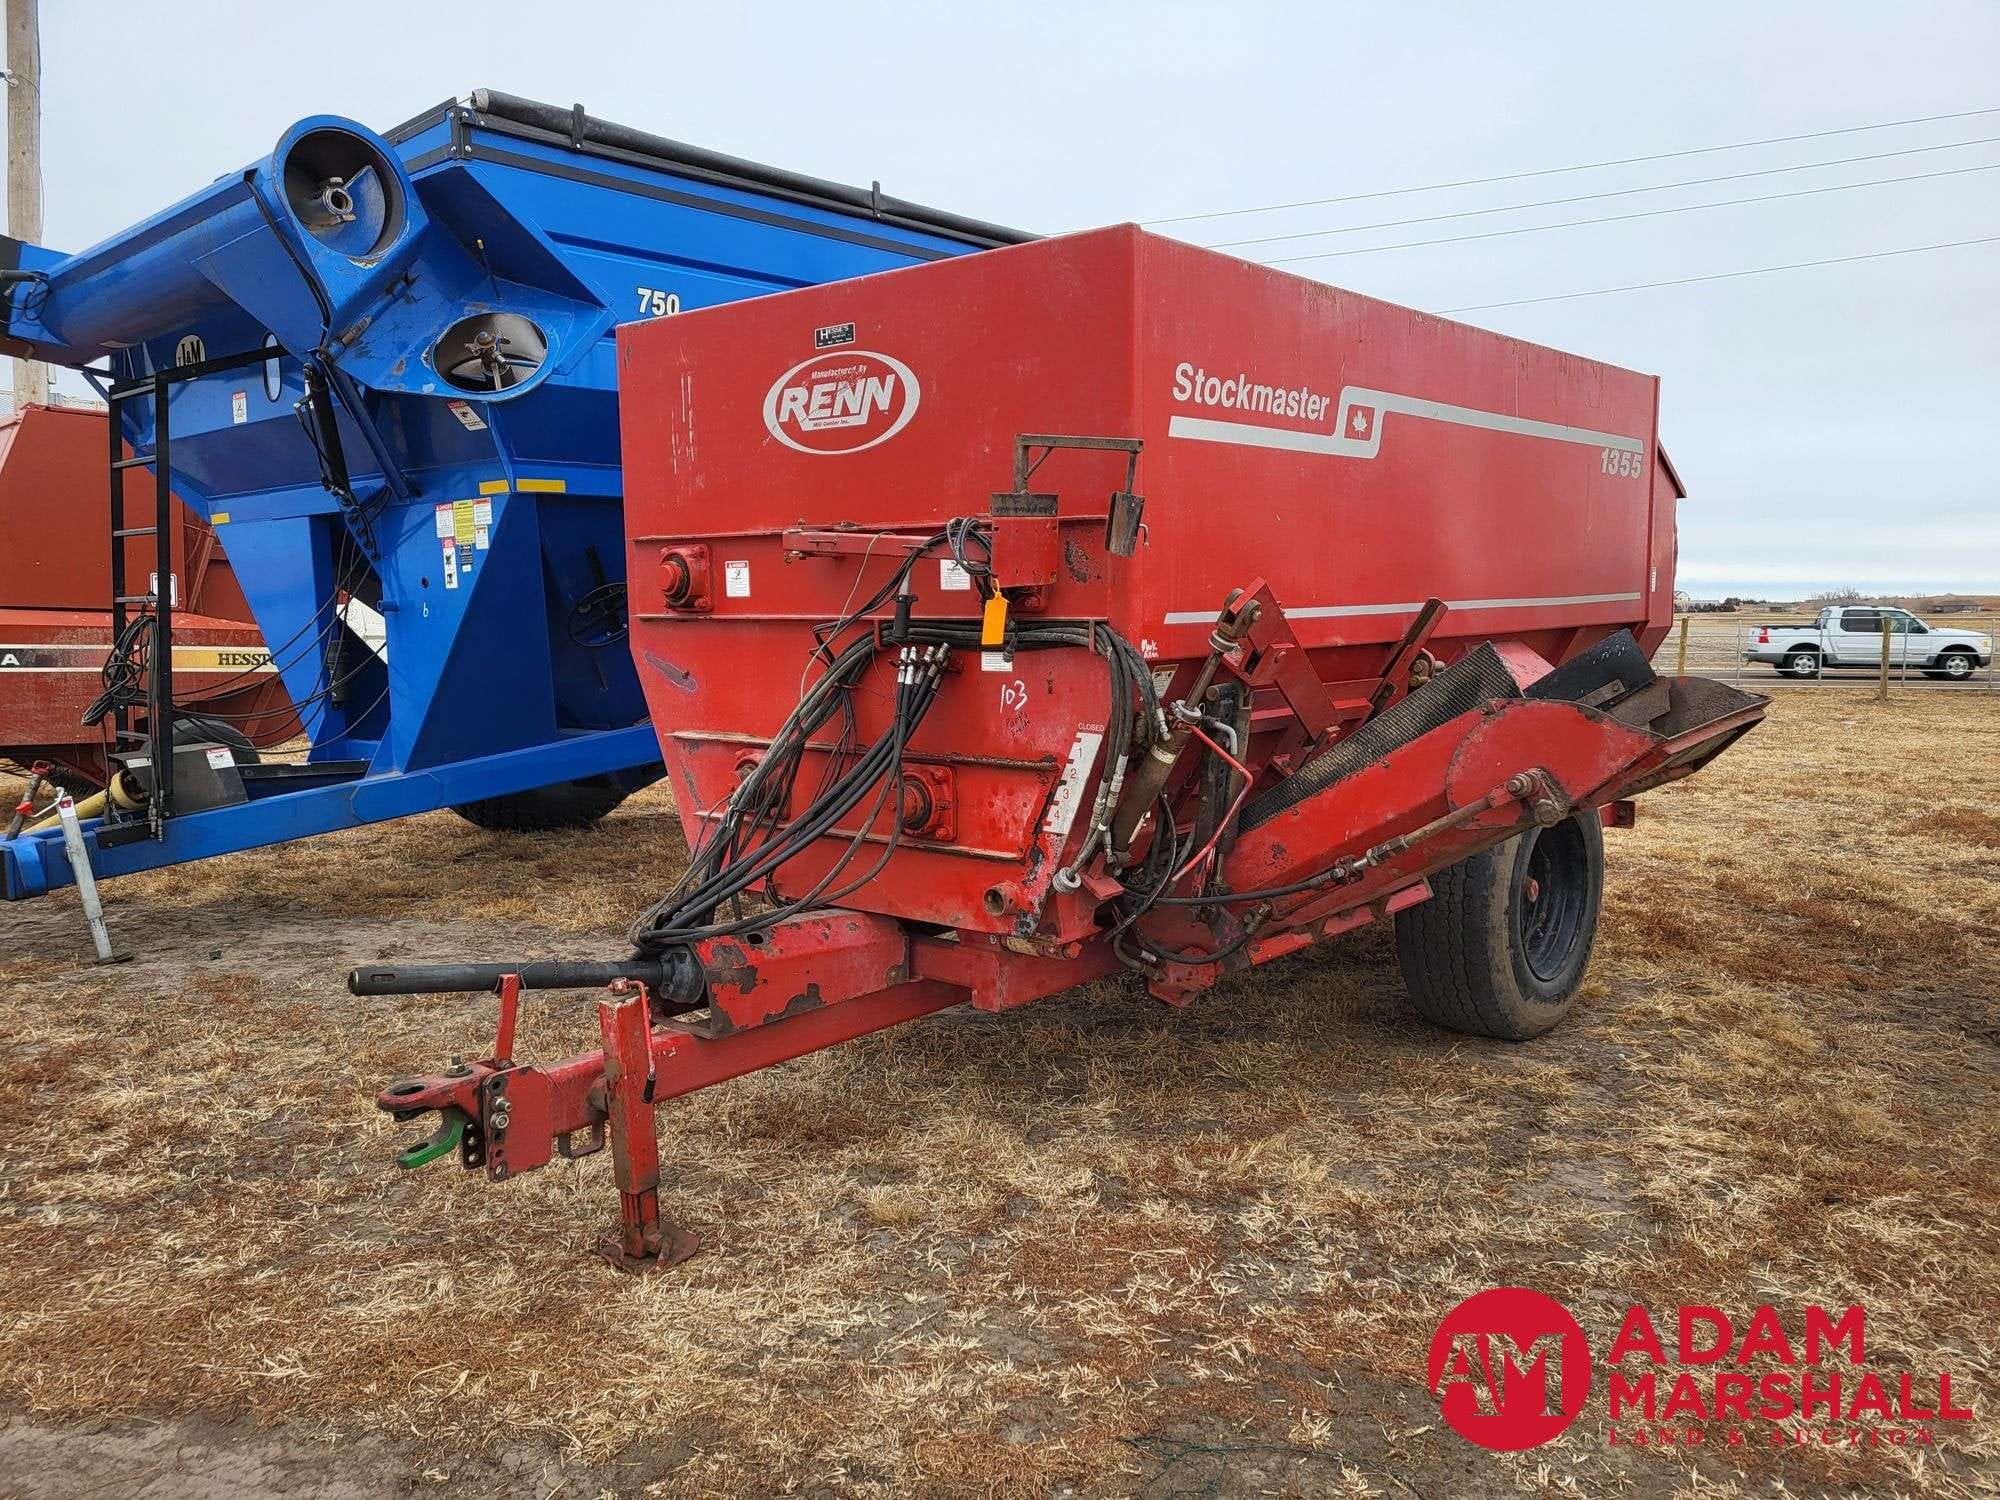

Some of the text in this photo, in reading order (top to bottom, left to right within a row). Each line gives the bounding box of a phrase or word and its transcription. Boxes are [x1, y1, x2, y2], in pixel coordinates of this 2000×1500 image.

[637, 287, 680, 316] 750
[811, 366, 857, 379] Manufactured
[1172, 362, 1330, 421] Stockmaster
[779, 374, 896, 424] RENN
[1601, 448, 1642, 479] 1355
[1000, 680, 1028, 713] 103
[1078, 722, 1105, 732] CLOSED
[1076, 747, 1082, 758] 1
[1070, 768, 1077, 780] 2
[1062, 788, 1070, 800] 3
[1053, 810, 1060, 819] 4
